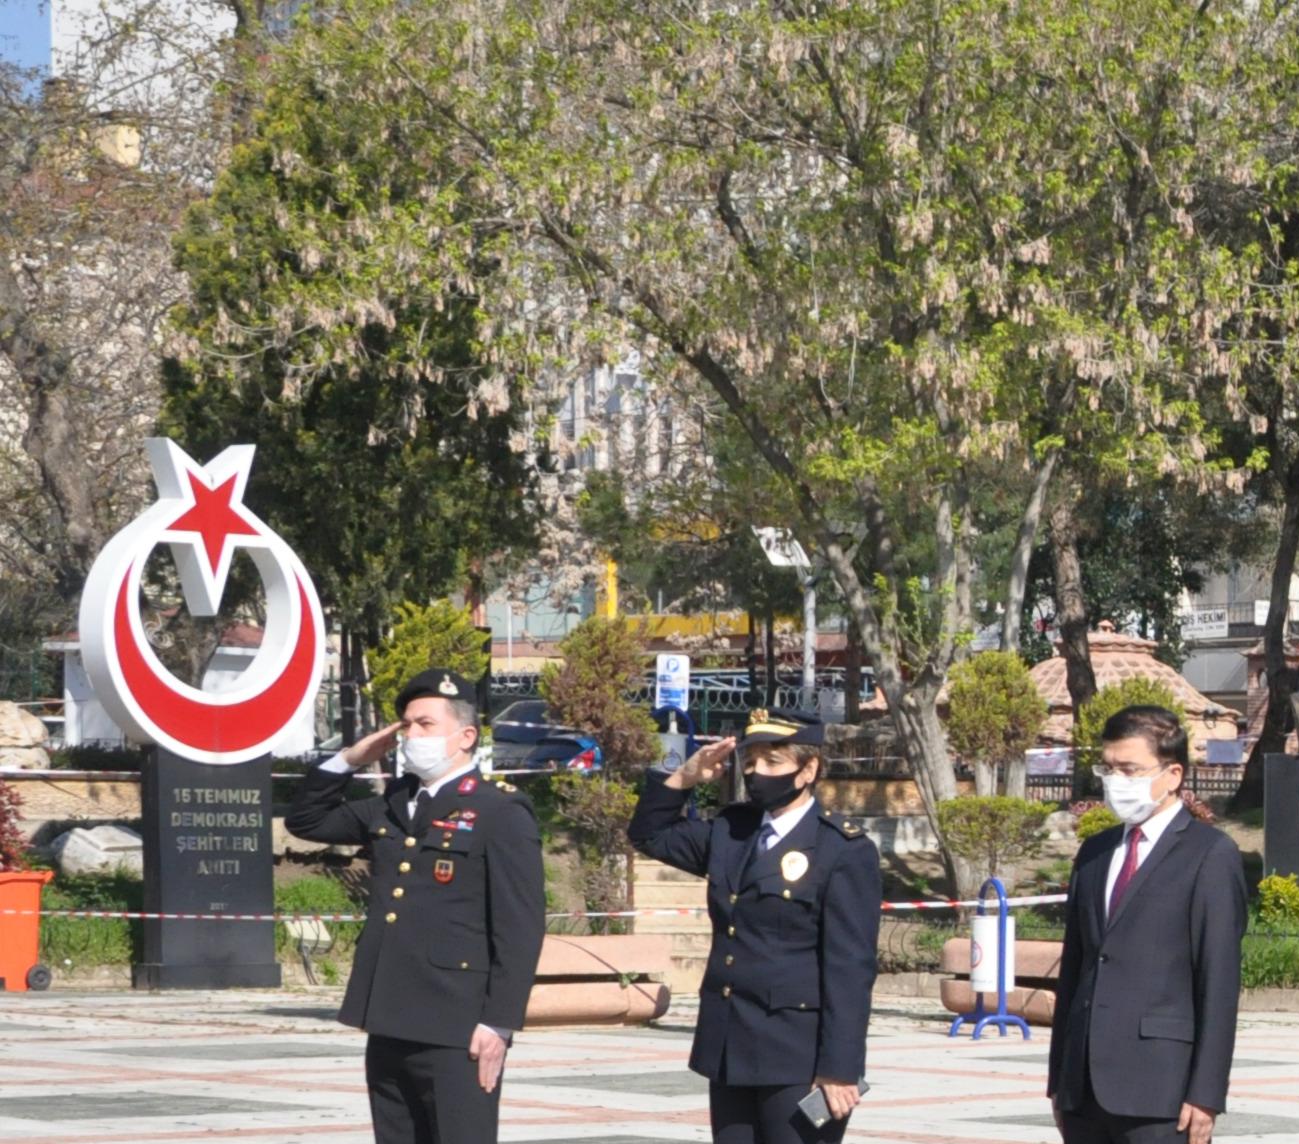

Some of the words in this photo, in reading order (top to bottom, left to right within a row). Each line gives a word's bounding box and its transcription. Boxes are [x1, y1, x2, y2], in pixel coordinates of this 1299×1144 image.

[173, 788, 190, 803] 15
[194, 788, 261, 804] TEMMUZ
[170, 810, 263, 828] DEMOKRASİ
[176, 832, 258, 853] ŞEHİTLERİ
[196, 859, 241, 875] ANITI
